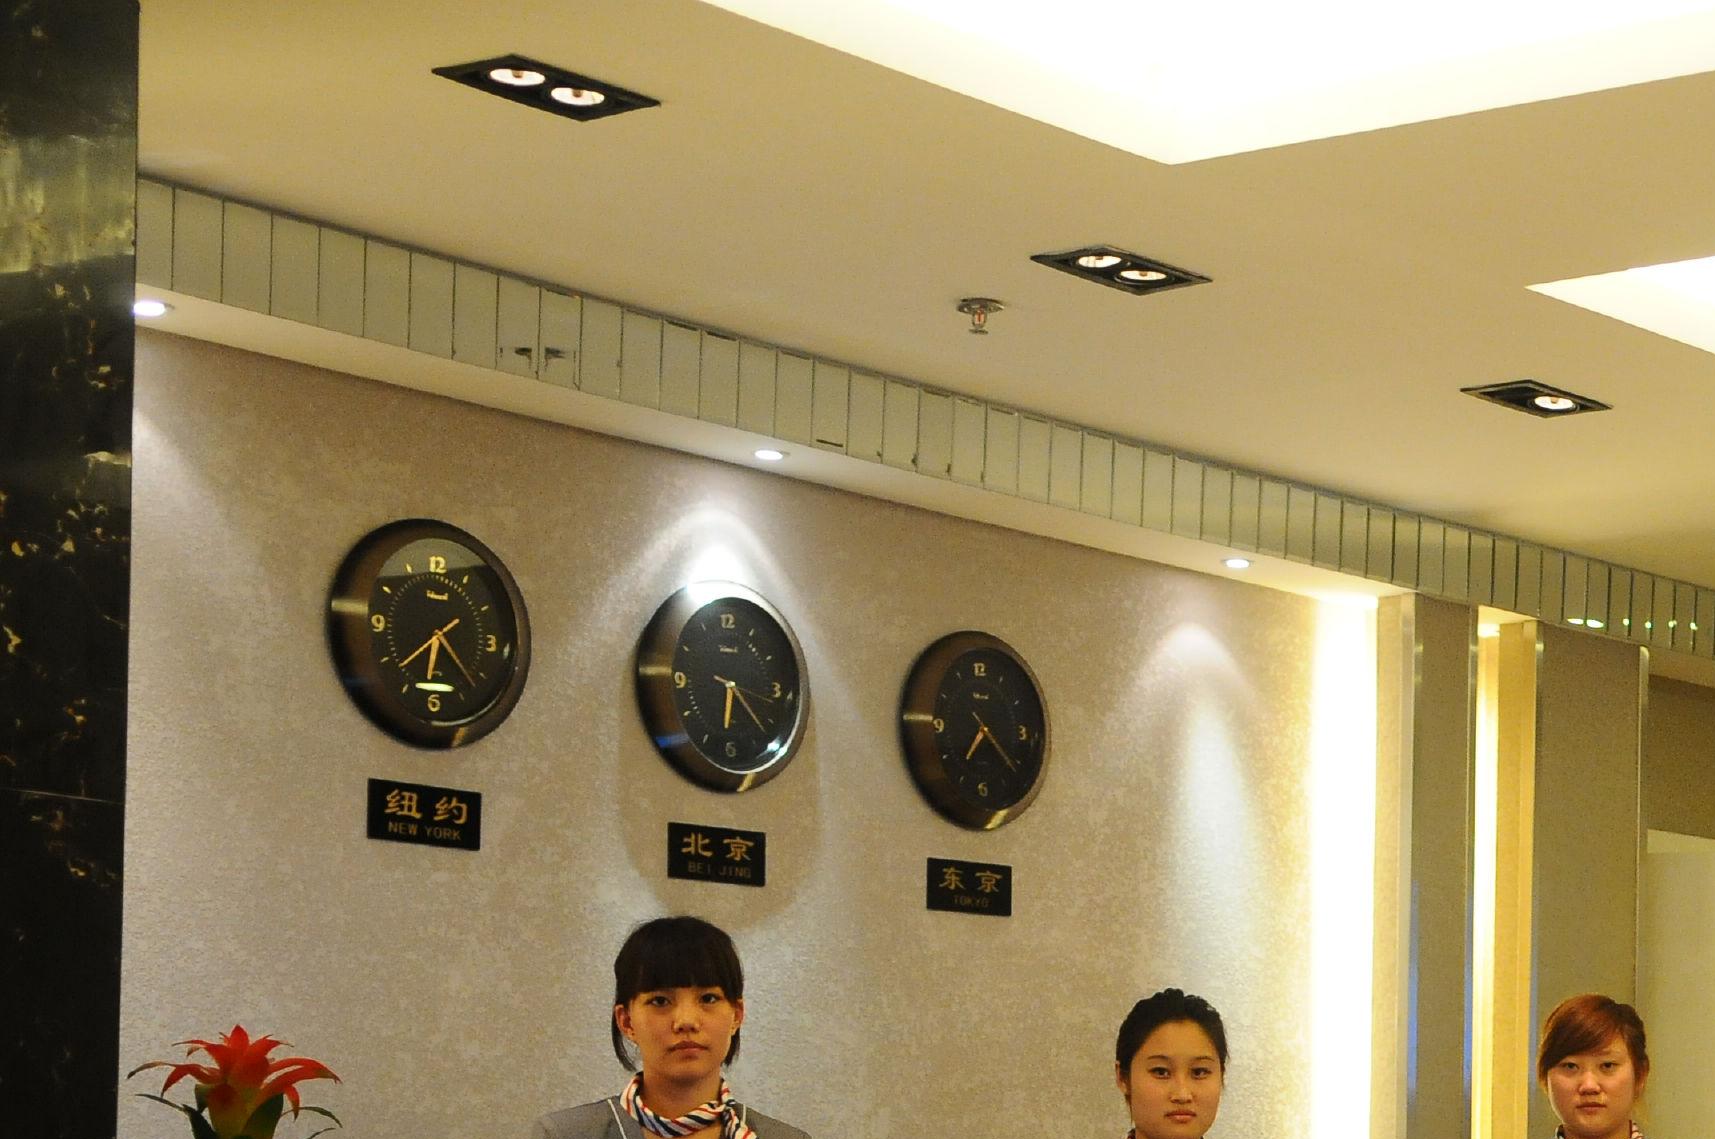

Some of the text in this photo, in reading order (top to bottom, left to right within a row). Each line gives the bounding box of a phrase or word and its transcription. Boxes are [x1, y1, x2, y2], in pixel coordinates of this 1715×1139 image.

[429, 556, 447, 573] 12
[371, 614, 386, 632] 9
[720, 613, 735, 629] 12
[486, 634, 497, 652] 3
[674, 671, 687, 689] 9
[772, 682, 781, 698] 3
[427, 694, 441, 712] 6
[933, 718, 945, 733] 9
[1018, 725, 1028, 740] 3
[384, 788, 468, 824] 纽约
[388, 821, 461, 839] NEW YORK
[681, 832, 754, 860] 北京
[939, 866, 1003, 893] 东京
